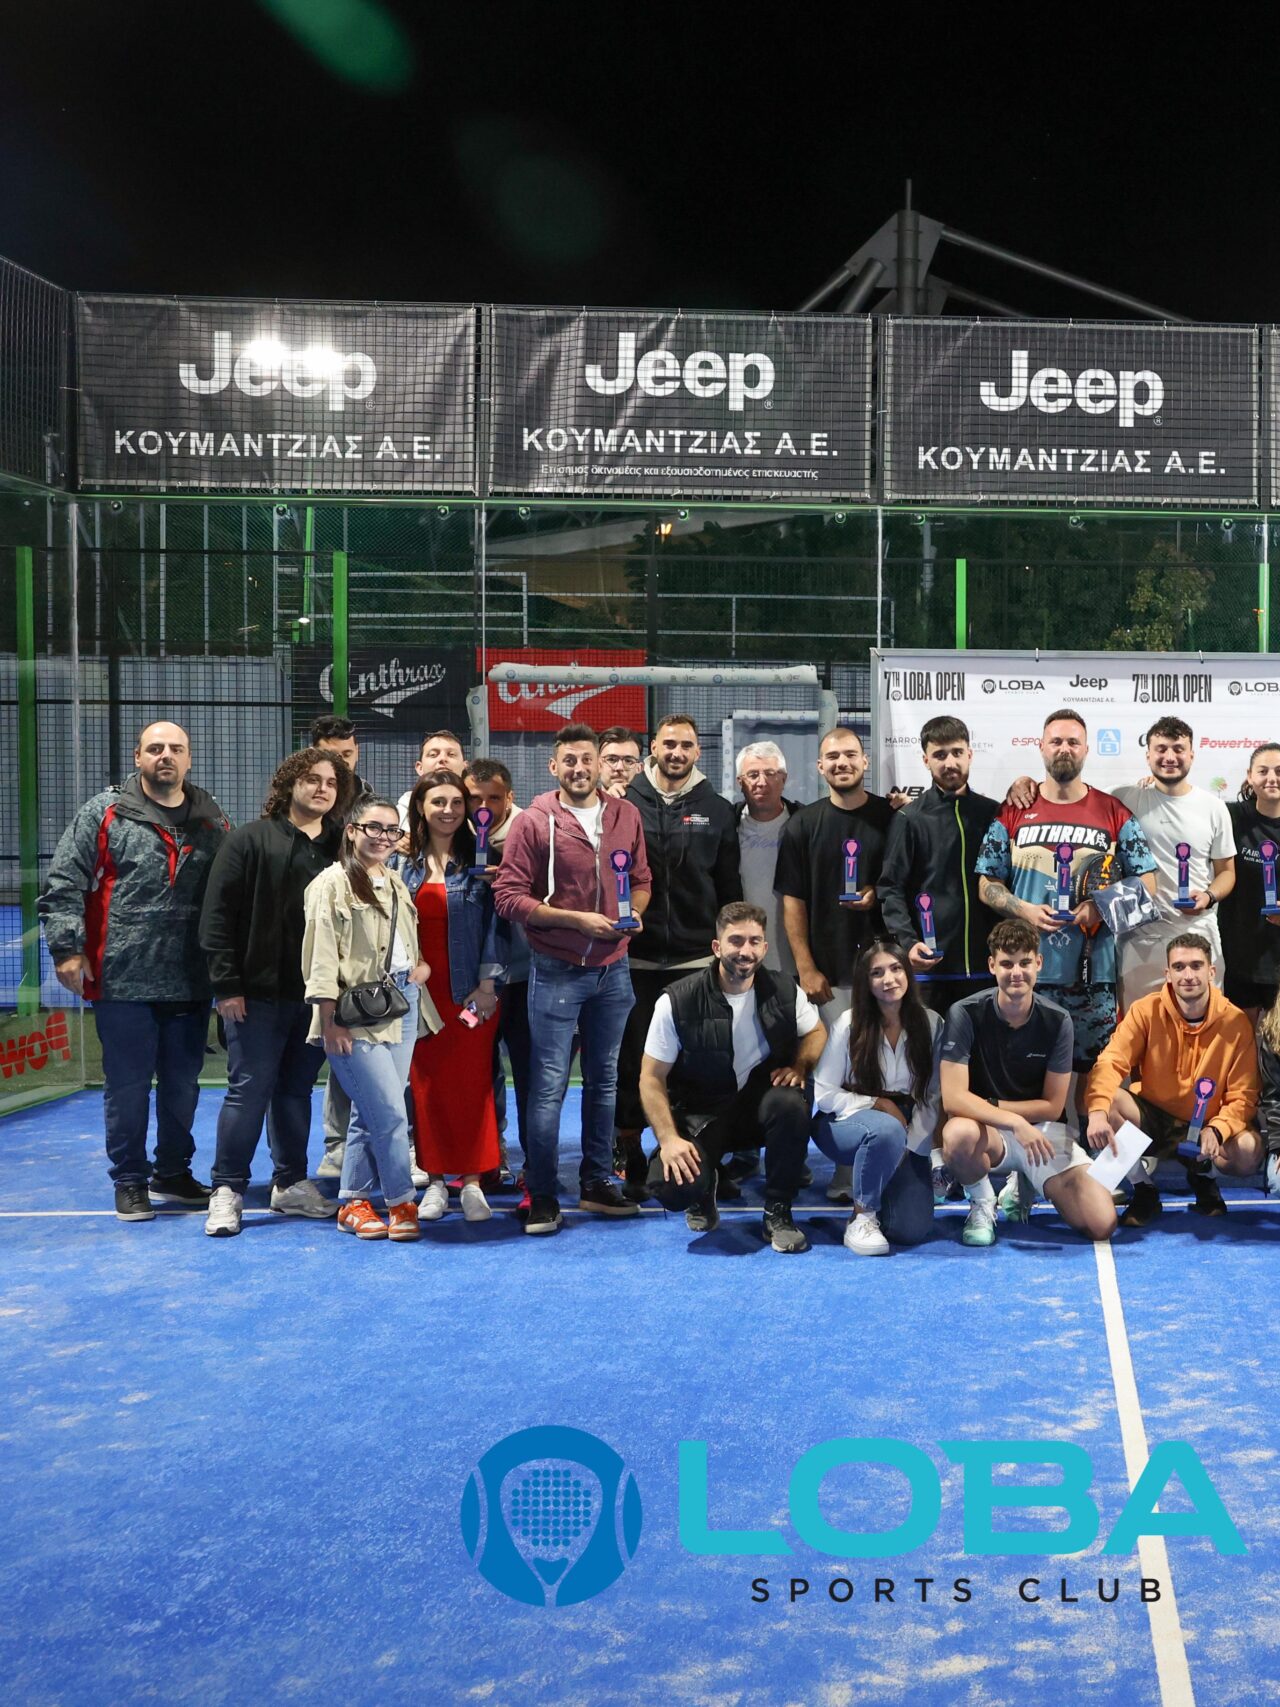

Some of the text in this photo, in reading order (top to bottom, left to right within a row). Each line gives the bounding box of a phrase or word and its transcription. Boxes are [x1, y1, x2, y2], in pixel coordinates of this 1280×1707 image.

[178, 331, 377, 411] Jeep
[585, 332, 775, 411] Jeep
[979, 350, 1164, 427] Jeep
[114, 430, 441, 460] ΚΟΥΜΑΝΤΖΙΑΣ Α.Ε.
[522, 427, 838, 457] ΚΟΥΜΑΝΤΖΙΑΣ Α.Ε.
[918, 446, 1226, 474] ΚΟΥΜΑΝΤΖΙΑΣ Α.Ε.
[903, 671, 932, 701] LOBA
[936, 671, 965, 701] OPEN
[999, 680, 1045, 690] LOBA
[1069, 674, 1108, 690] Jeep
[1151, 674, 1180, 703] LOBA
[1183, 674, 1212, 703] OPEN
[1016, 825, 1098, 846] ANTHRAX
